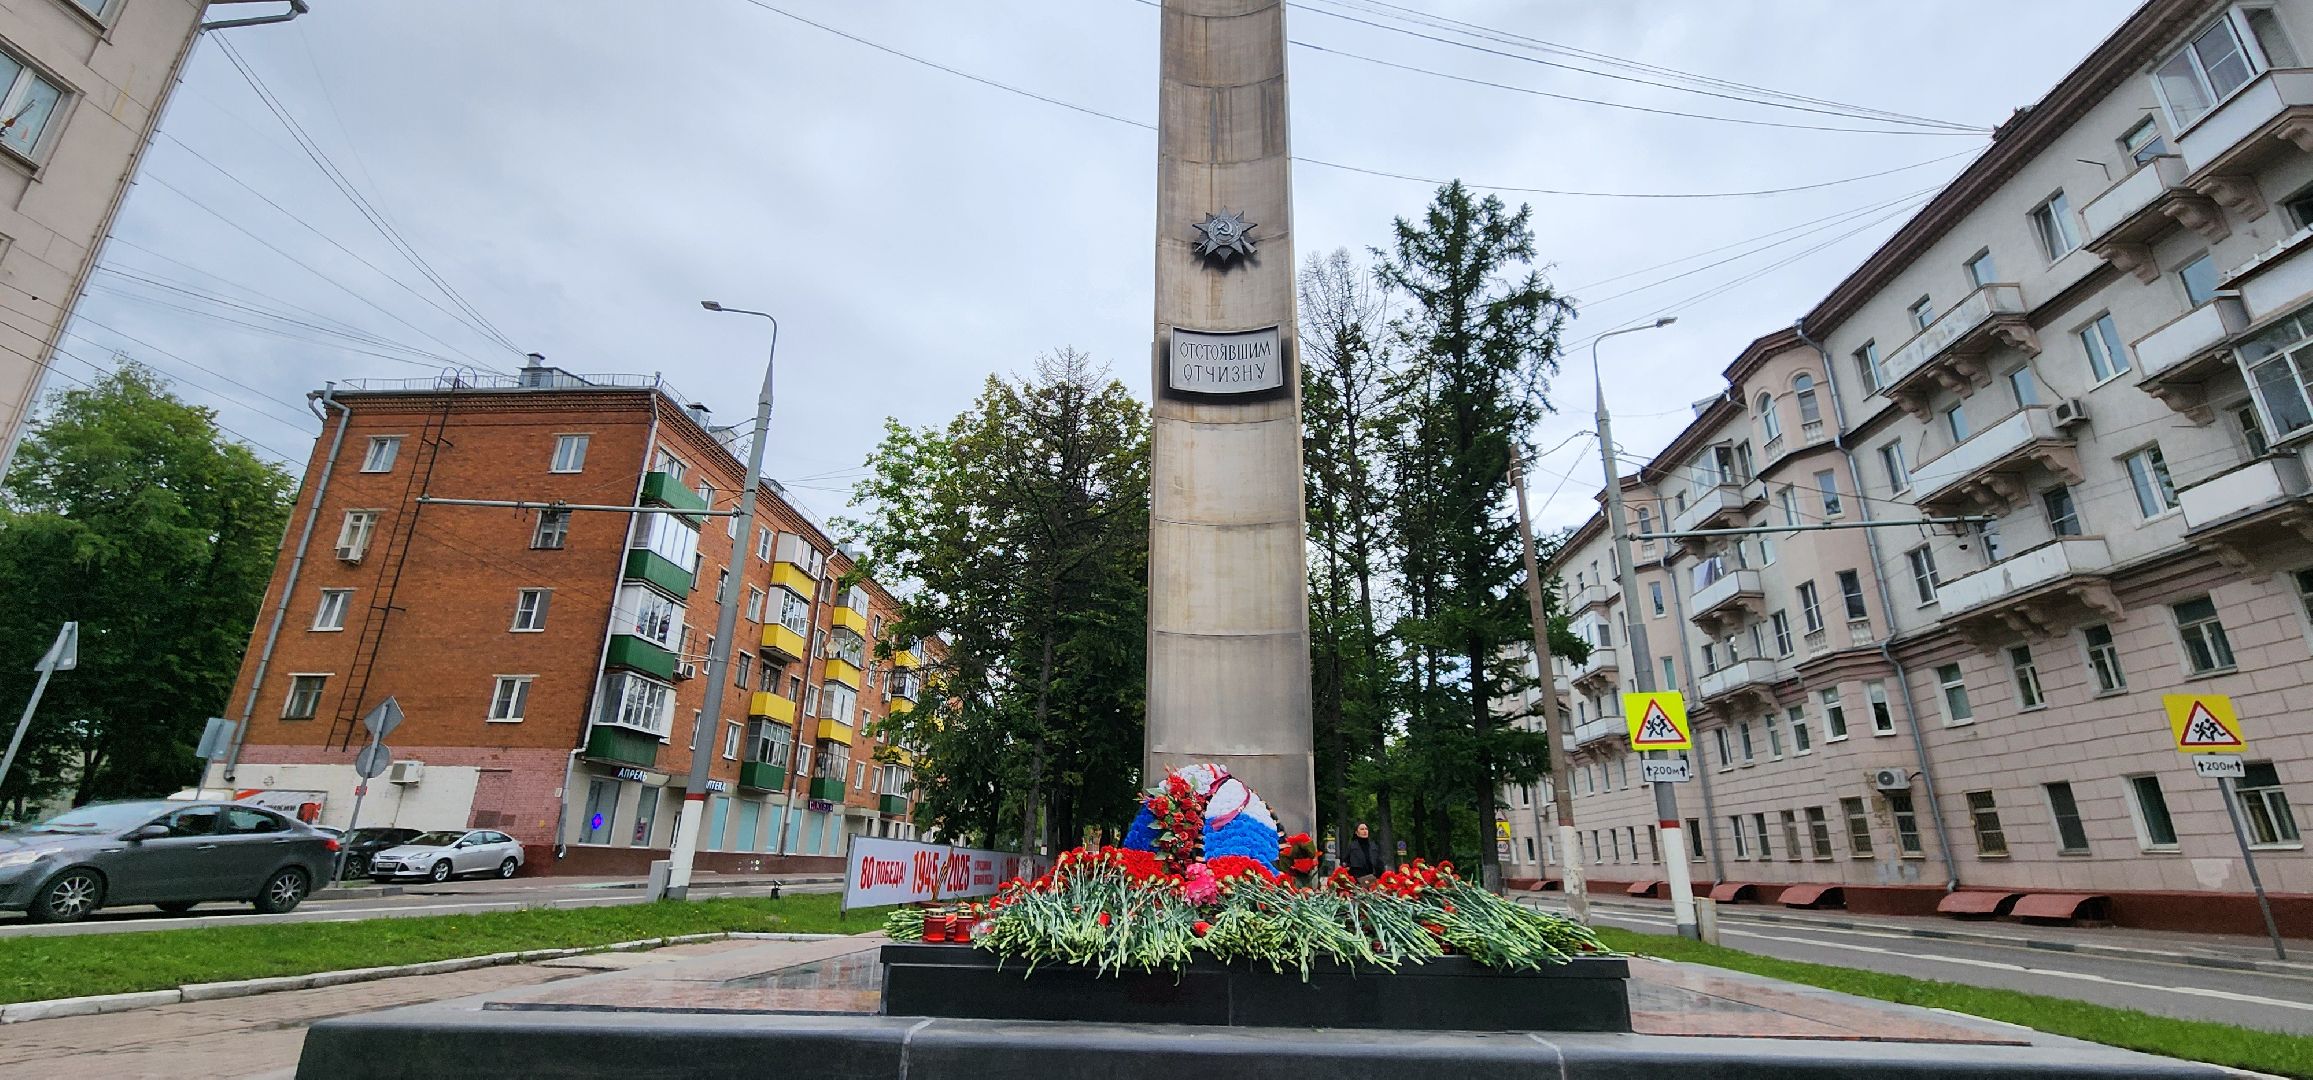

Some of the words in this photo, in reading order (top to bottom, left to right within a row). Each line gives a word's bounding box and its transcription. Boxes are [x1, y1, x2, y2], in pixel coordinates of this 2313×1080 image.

[1180, 341, 1271, 361] ОТСТОЯВШИМ
[1183, 362, 1266, 383] ОТЧИЗНУ
[618, 768, 648, 782] АПРЕЛЬ
[1653, 766, 1680, 775] 200м
[860, 856, 875, 890] 80
[874, 860, 907, 888] ПОБЕДА!
[912, 850, 940, 894] 1945
[946, 853, 971, 892] 2025
